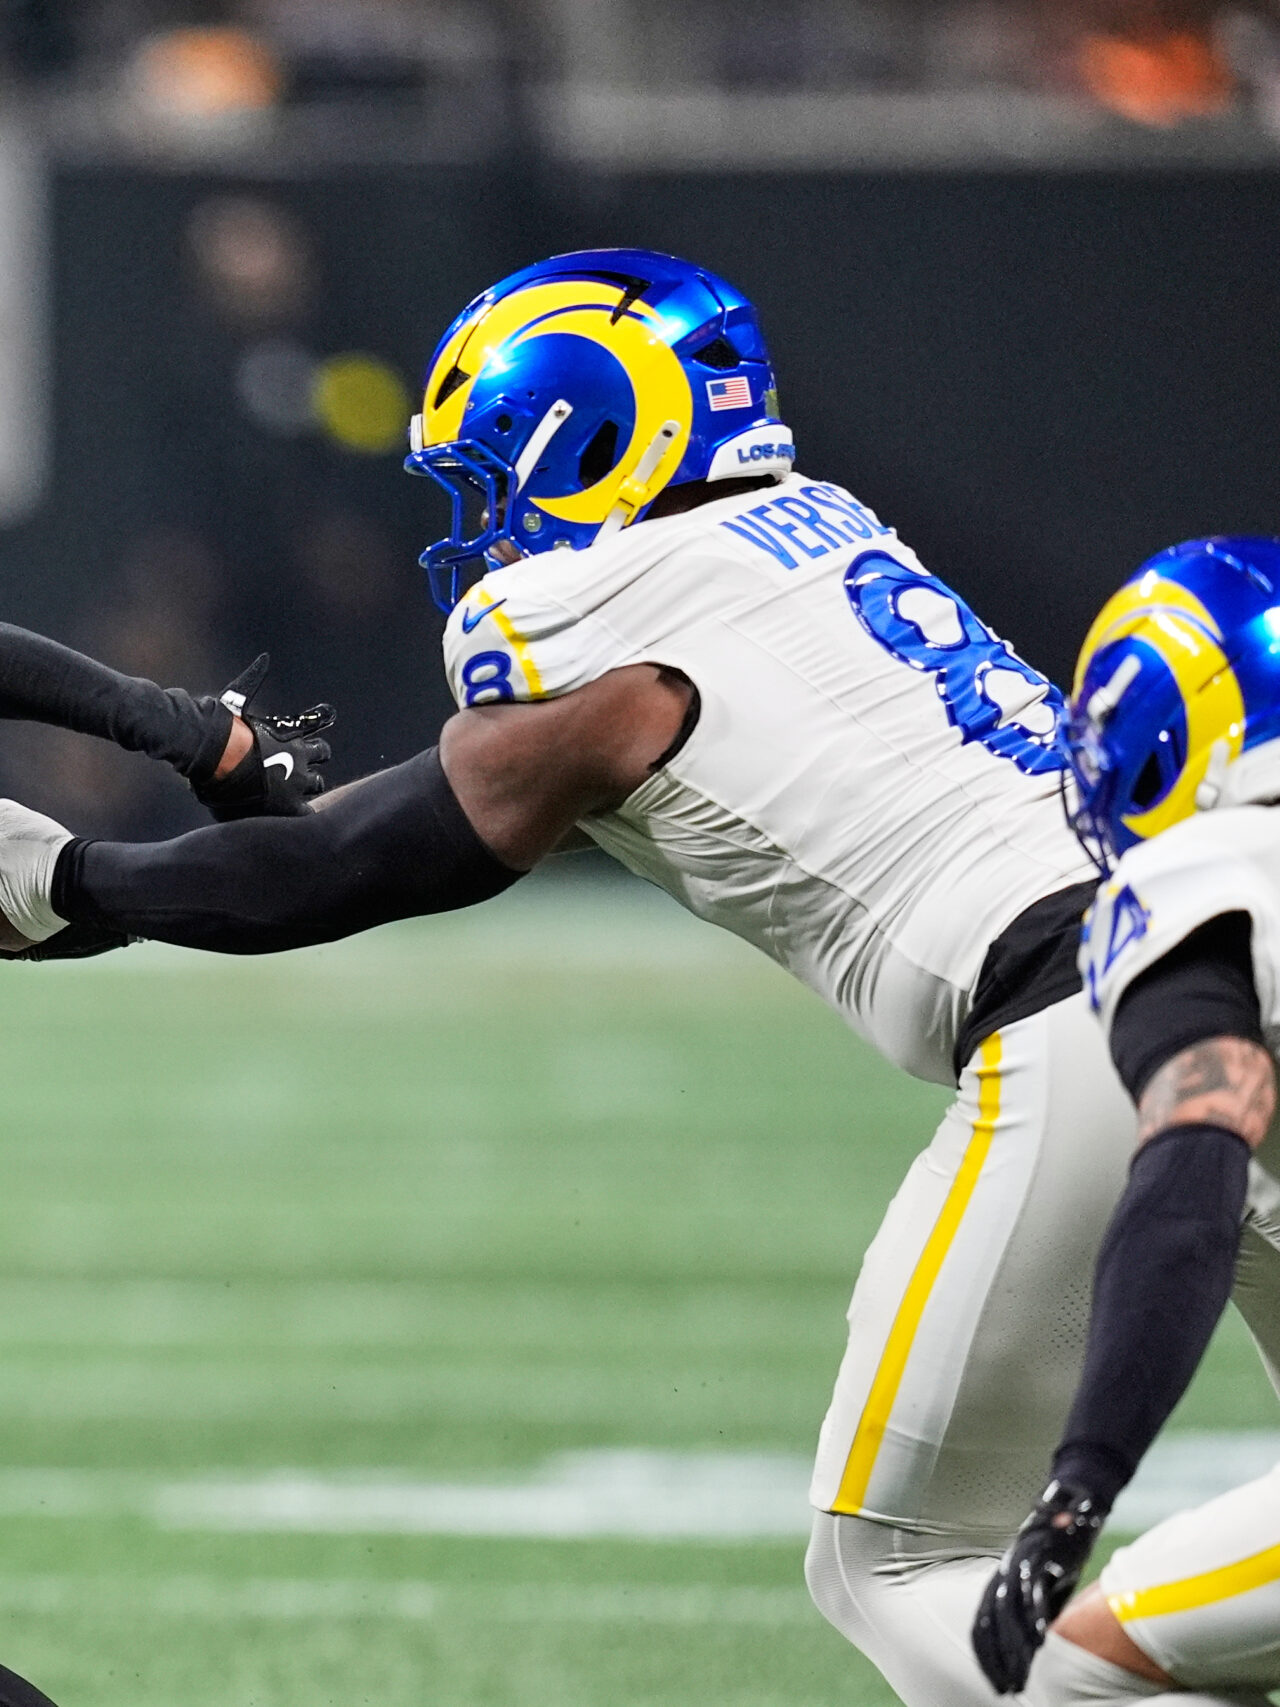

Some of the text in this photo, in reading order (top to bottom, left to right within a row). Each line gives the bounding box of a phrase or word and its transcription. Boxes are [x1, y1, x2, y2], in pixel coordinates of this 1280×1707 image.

[719, 485, 892, 570] VERSE
[462, 651, 514, 707] 8
[844, 549, 1071, 776] 8
